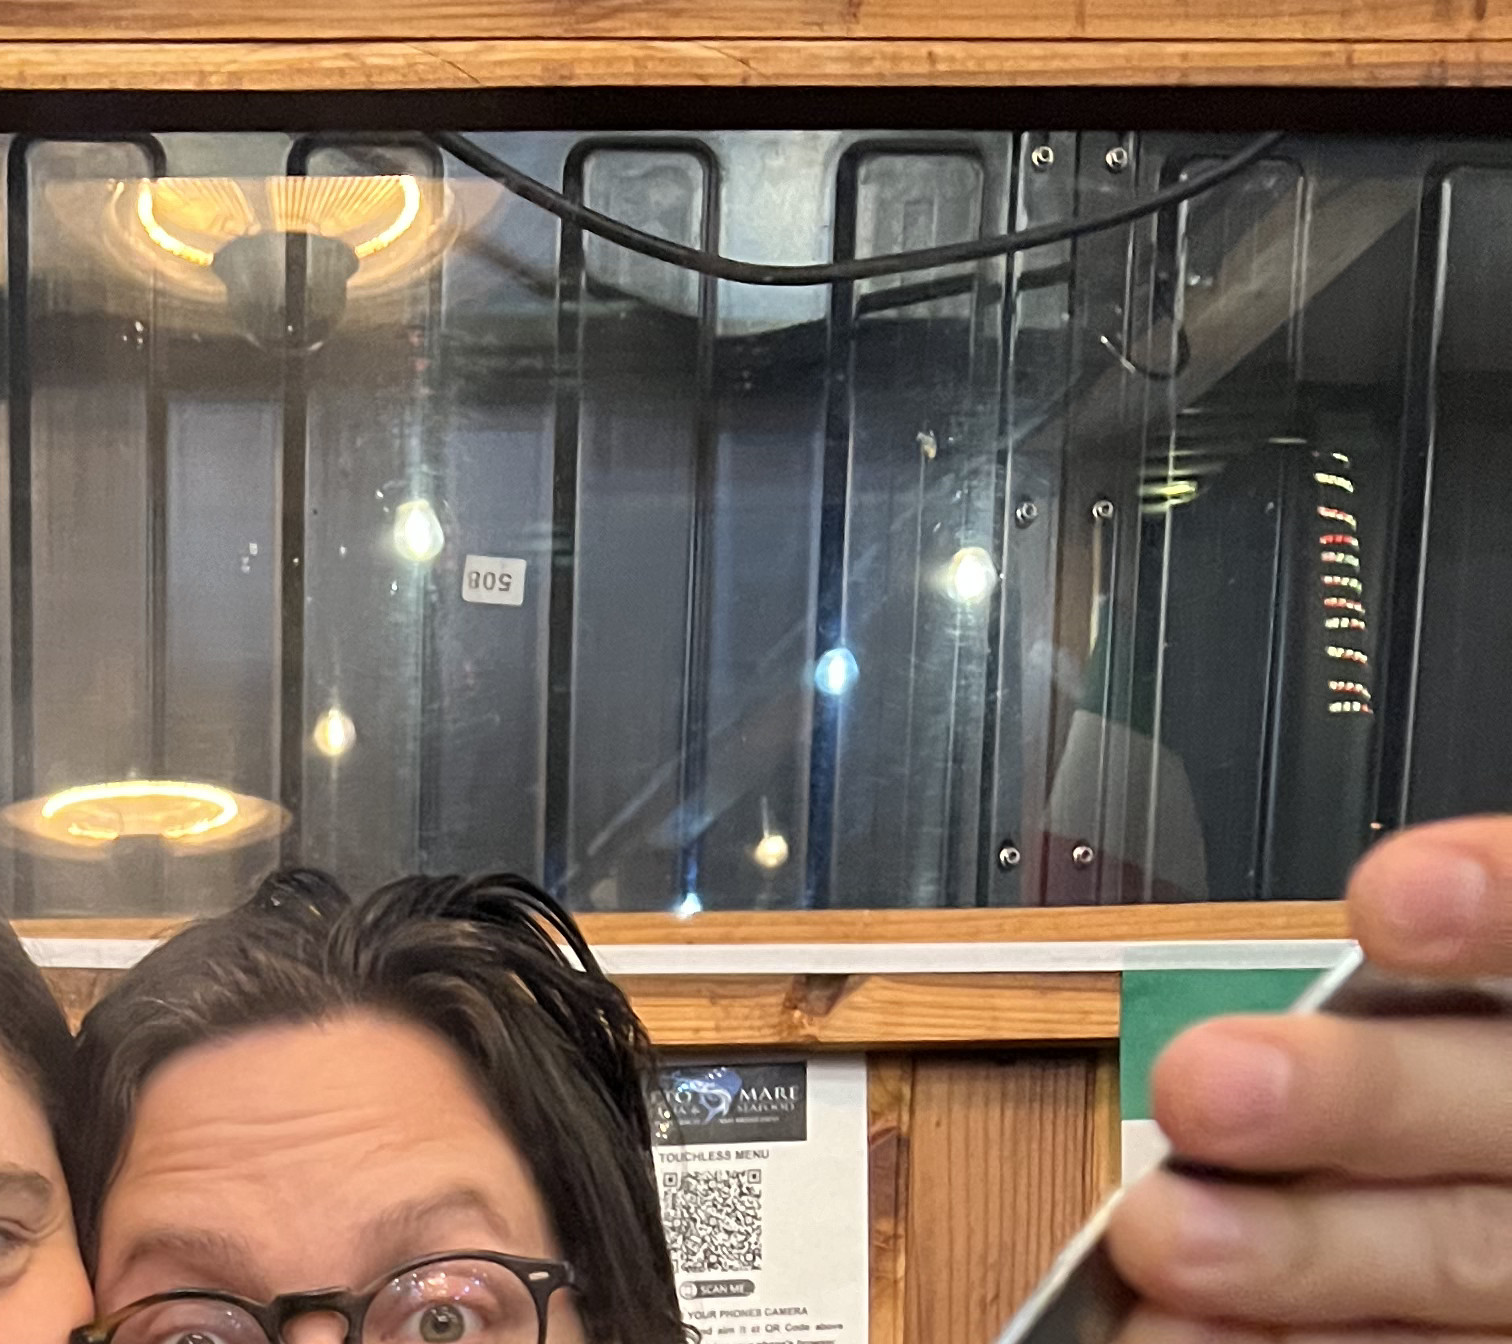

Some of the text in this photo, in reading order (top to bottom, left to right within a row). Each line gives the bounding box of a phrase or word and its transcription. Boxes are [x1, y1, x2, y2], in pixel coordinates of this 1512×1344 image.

[467, 571, 513, 592] 508
[739, 1085, 800, 1101] MARE
[658, 1149, 770, 1163] TOUCHLESS MENU
[700, 1284, 745, 1295] SCAN ME
[687, 1310, 717, 1320] YOUR
[764, 1307, 808, 1317] CAMERA
[764, 1323, 781, 1334] QR
